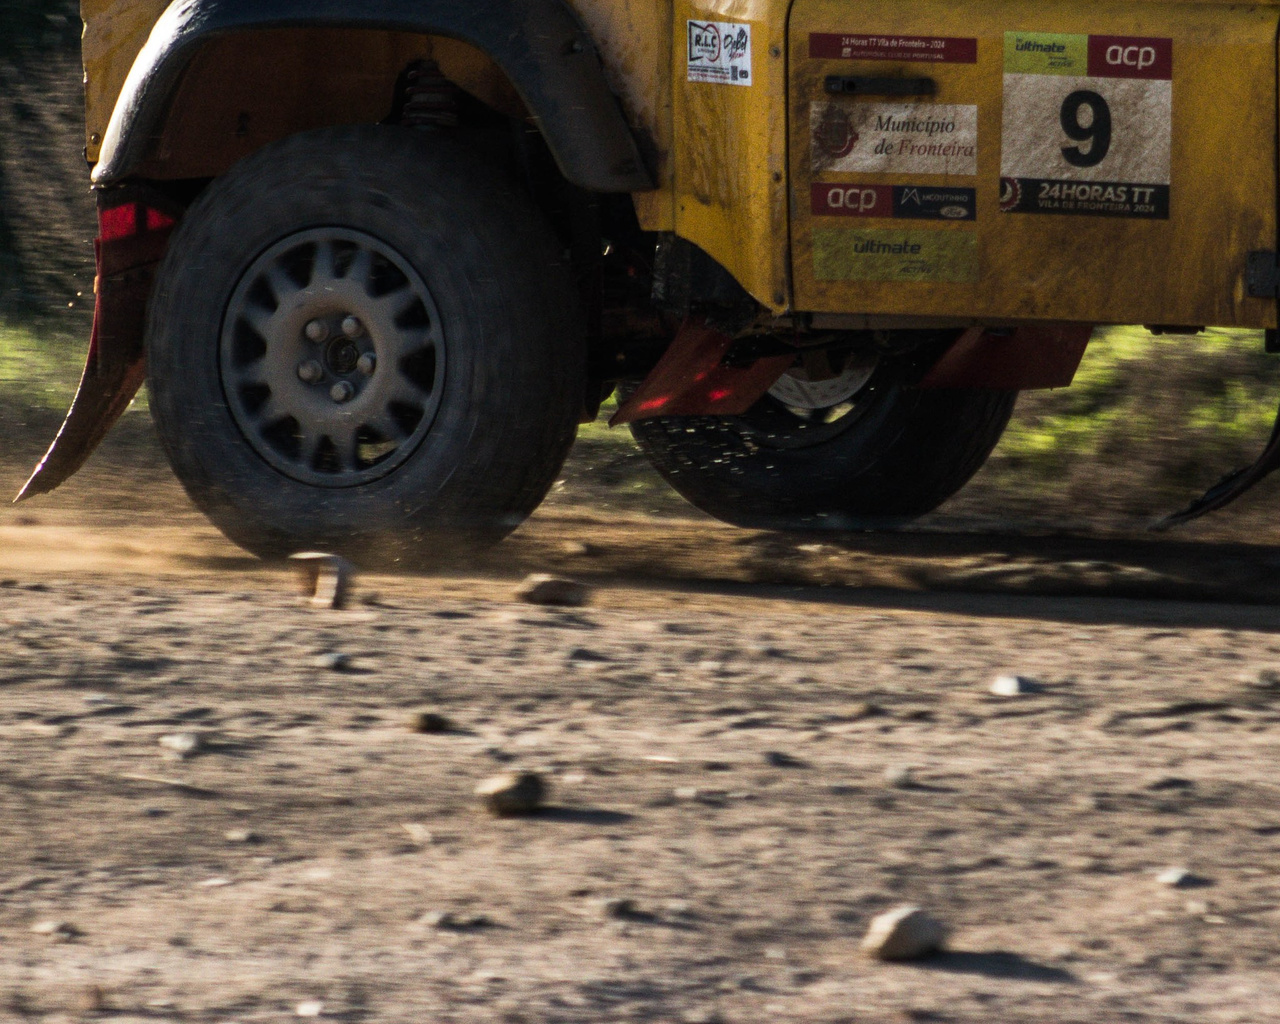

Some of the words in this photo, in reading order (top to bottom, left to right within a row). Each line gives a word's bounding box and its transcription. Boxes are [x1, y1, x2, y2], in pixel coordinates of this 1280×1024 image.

[842, 37, 850, 46] 24
[850, 38, 868, 47] Horas
[877, 39, 889, 48] Vila
[890, 39, 898, 48] de
[899, 39, 926, 49] Fronteira
[930, 41, 945, 49] 2024
[1016, 41, 1065, 53] ultimate
[1105, 45, 1156, 70] acp
[874, 114, 955, 137] Município
[1060, 90, 1112, 168] 9
[874, 138, 893, 155] de
[899, 139, 974, 157] Fronteira
[827, 188, 877, 212] acp
[1132, 187, 1155, 203] TT
[1038, 199, 1059, 208] VILA
[1077, 202, 1131, 212] FRONTEIRA
[1133, 203, 1155, 213] 2024
[854, 238, 921, 254] ultimate
